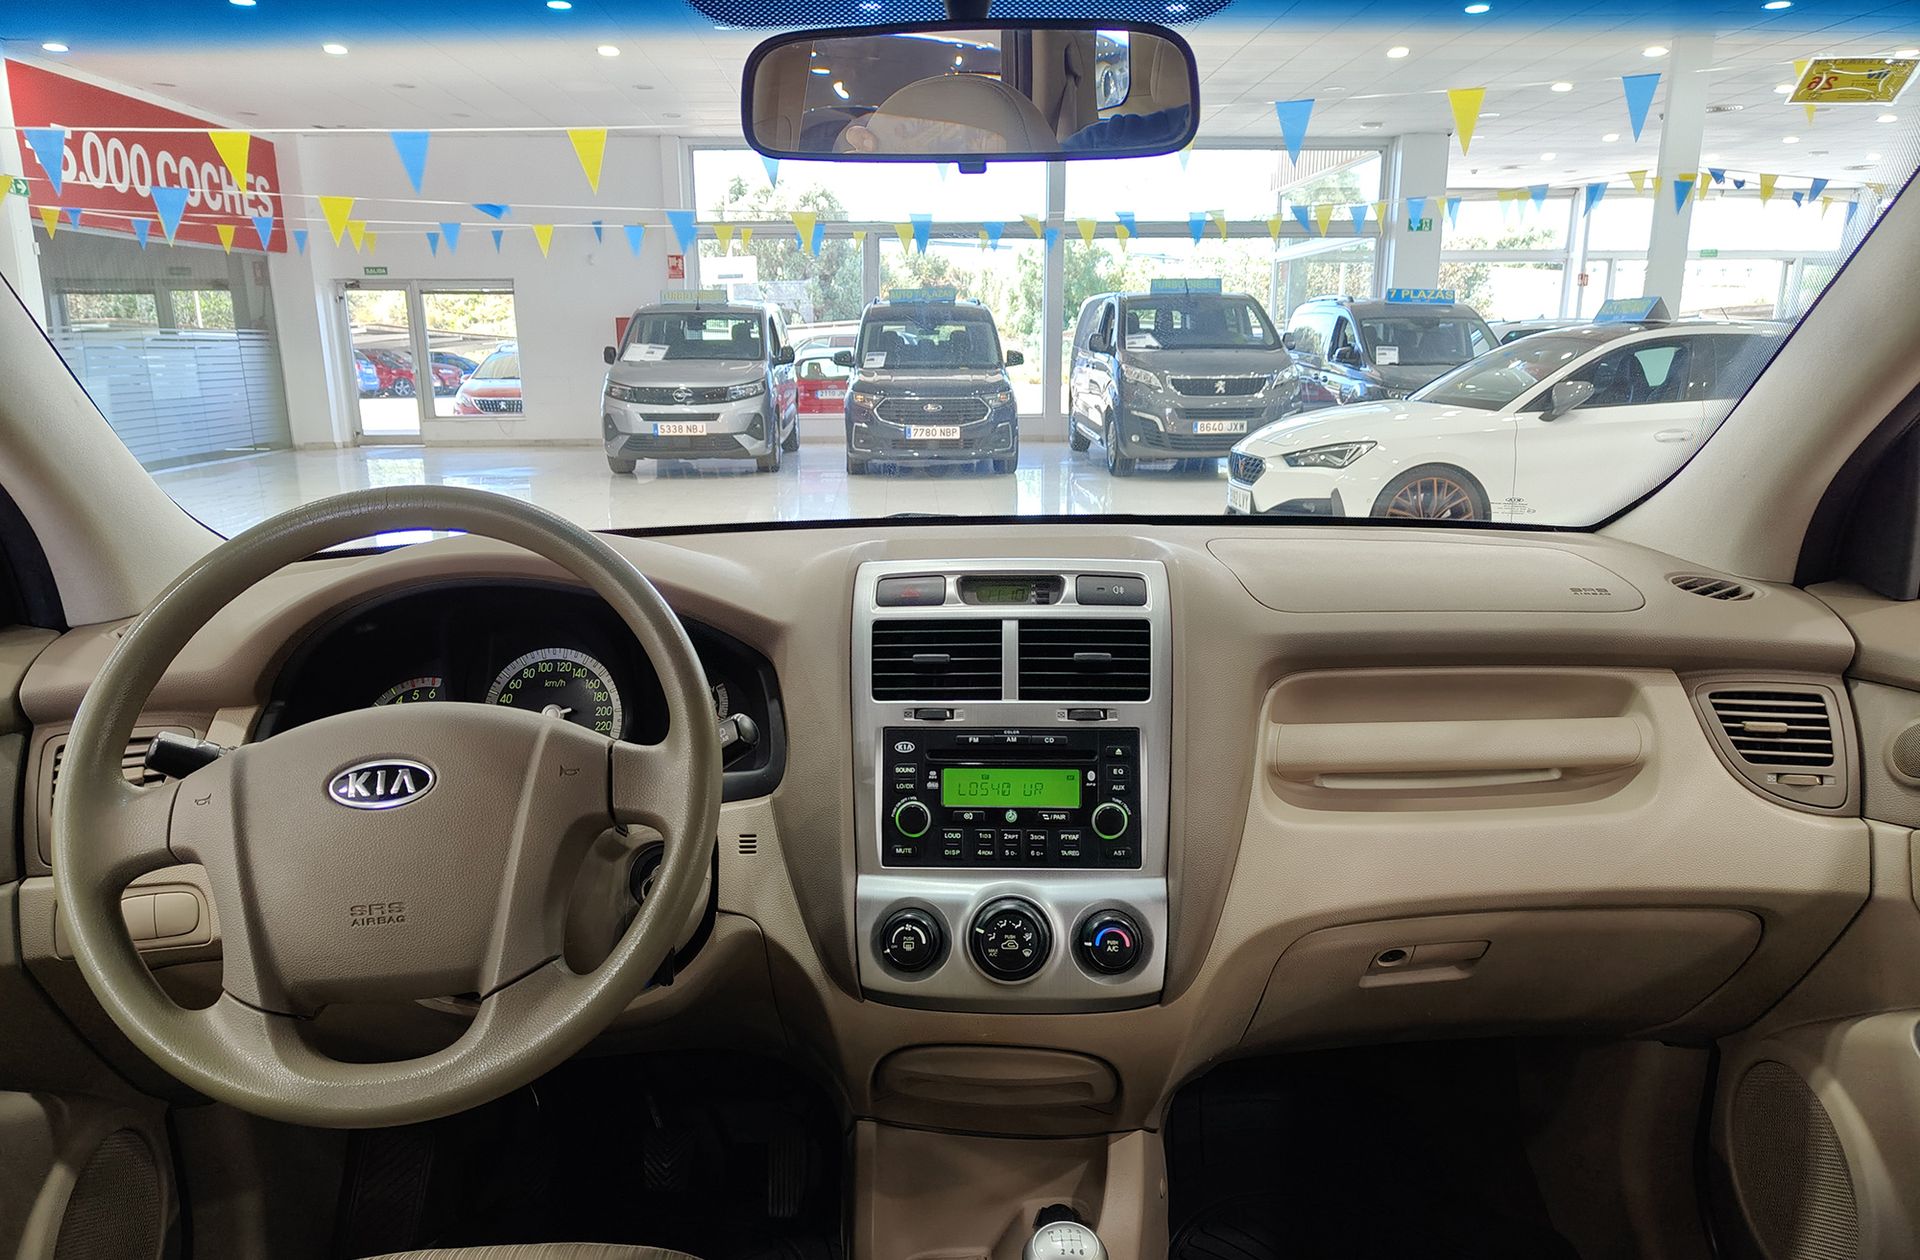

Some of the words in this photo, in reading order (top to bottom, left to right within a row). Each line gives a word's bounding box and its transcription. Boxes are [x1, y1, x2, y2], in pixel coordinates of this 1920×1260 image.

[156, 150, 274, 217] COCHES
[1390, 290, 1396, 298] 7
[1402, 290, 1454, 299] PLAZAS
[659, 424, 684, 434] 5338
[686, 424, 705, 434] NBJ
[1199, 422, 1224, 432] 8640
[1226, 422, 1245, 432] JXW
[913, 428, 938, 437] 7780
[939, 428, 958, 437] NBP
[538, 662, 553, 673] 100
[557, 662, 572, 672] 120
[522, 668, 535, 678] 80
[572, 668, 587, 678] 140
[509, 679, 522, 689] 60
[585, 679, 600, 689] 160
[412, 690, 420, 700] 5
[428, 688, 436, 699] 6
[593, 692, 608, 701] 180
[500, 694, 513, 704] 40
[595, 706, 612, 716] 200
[595, 721, 611, 731] 220
[347, 768, 417, 799] KIA
[1023, 782, 1043, 796] UR
[350, 902, 404, 917] SRS
[351, 915, 405, 927] AIRBAG
